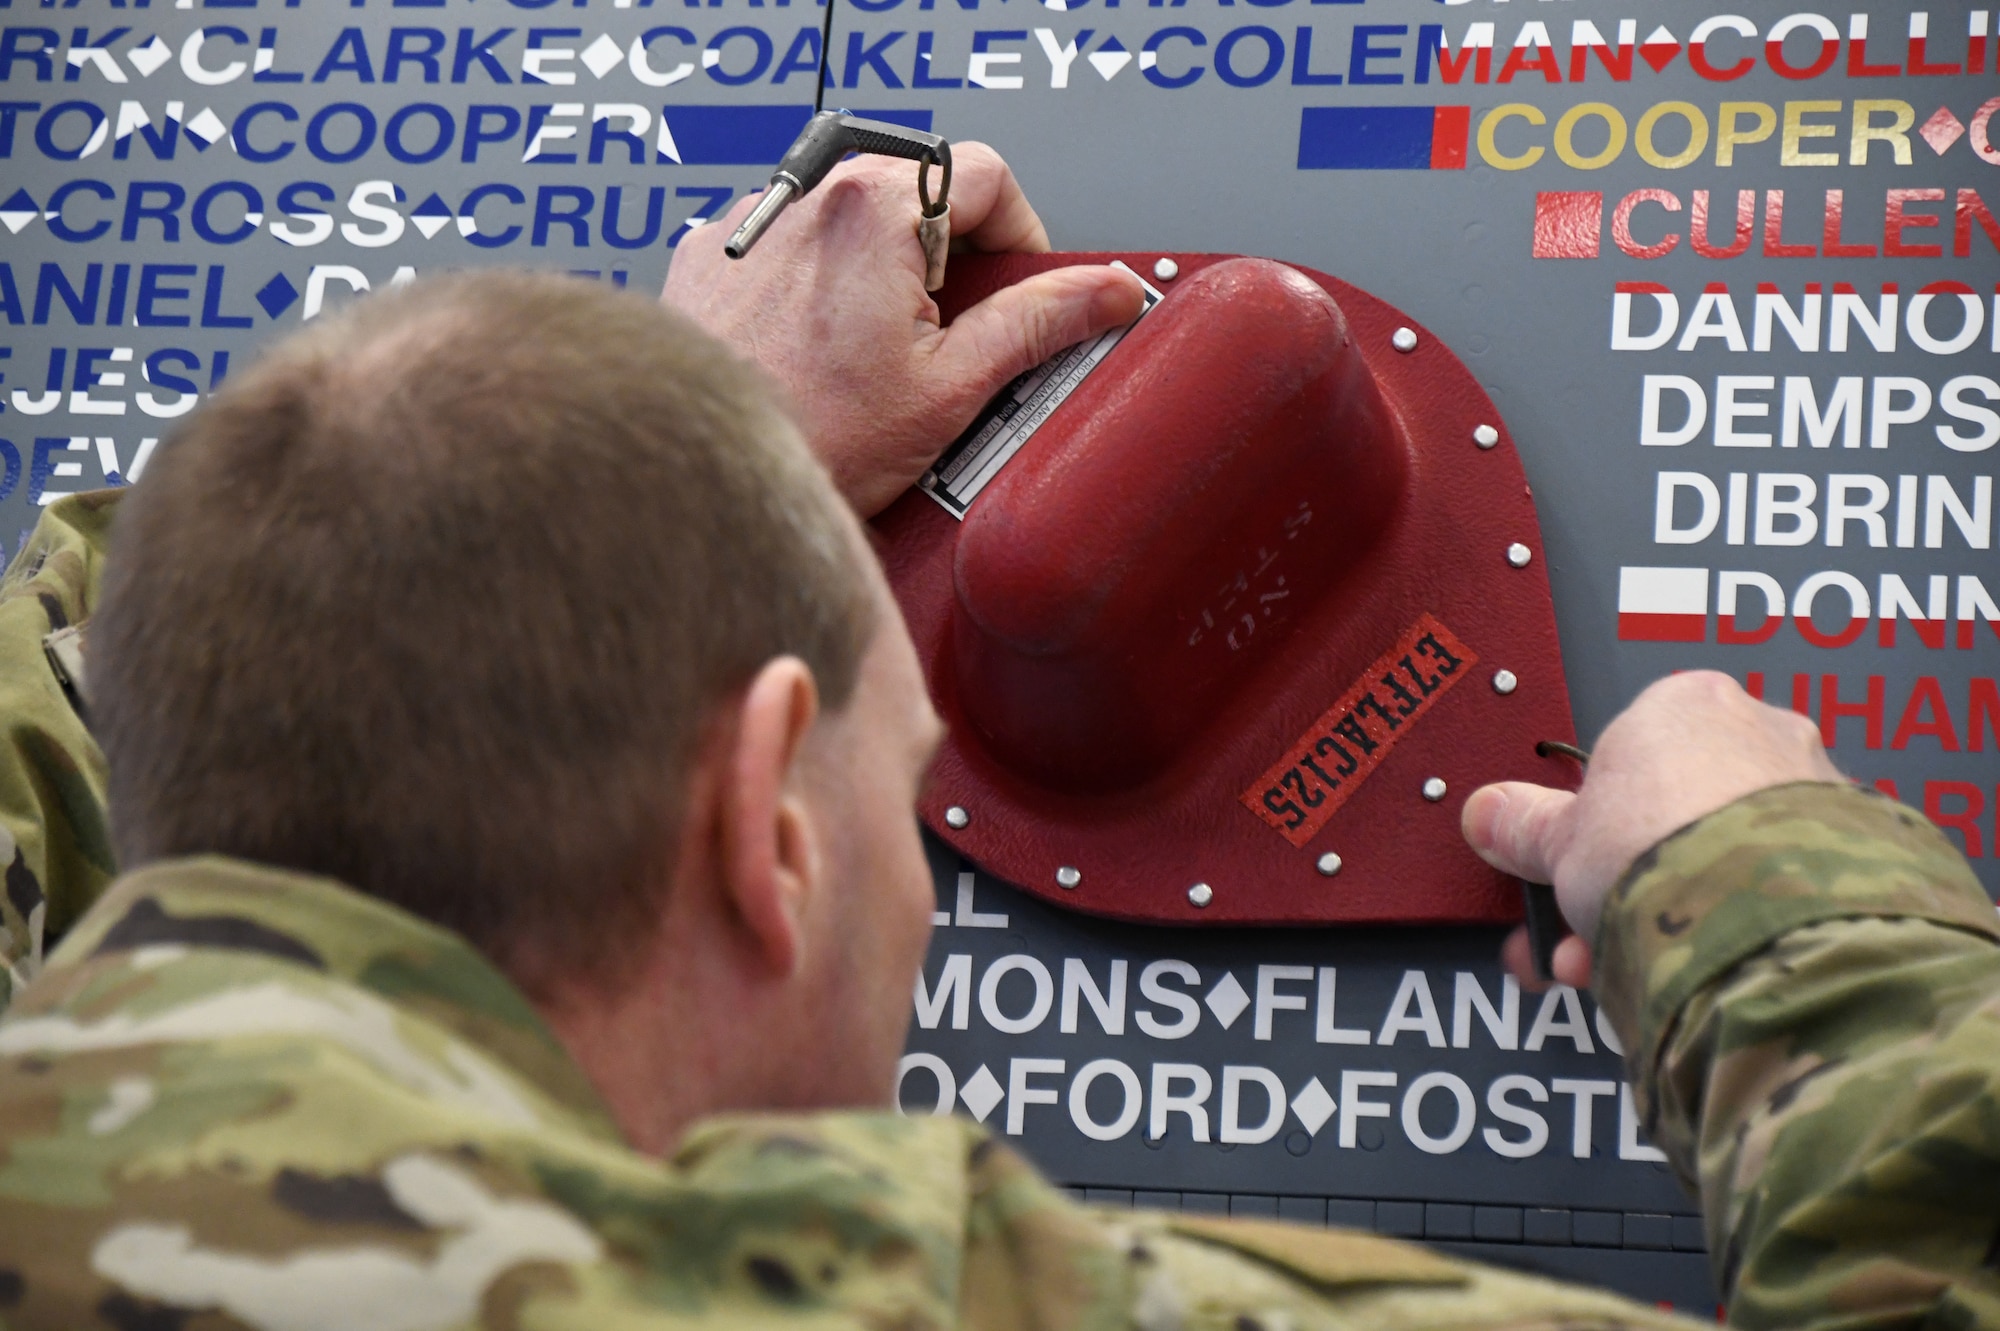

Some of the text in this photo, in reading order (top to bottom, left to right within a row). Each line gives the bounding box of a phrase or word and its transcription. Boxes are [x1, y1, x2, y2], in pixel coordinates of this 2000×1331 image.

[0, 10, 2000, 89] RK CLARKE COAKLEY COLEMAN COLLI
[0, 100, 651, 164] TON COOPER
[1477, 98, 1915, 170] COOPER
[44, 179, 406, 247] CROSS
[1611, 187, 2000, 259] CULLEN
[1611, 280, 2000, 355] DANNO
[1055, 347, 1083, 380] ATTACK
[1001, 402, 1018, 420] NSN
[1006, 377, 1056, 432] TRANSMITTER
[1027, 404, 1051, 432] ANGLE
[1640, 374, 2000, 452] DEMPS
[1655, 471, 1993, 549] DIBRIN
[1227, 575, 1290, 651] NO
[1716, 570, 2000, 650] DONN
[1255, 964, 1625, 1057] FLANA
[1007, 1057, 1287, 1145] FORD
